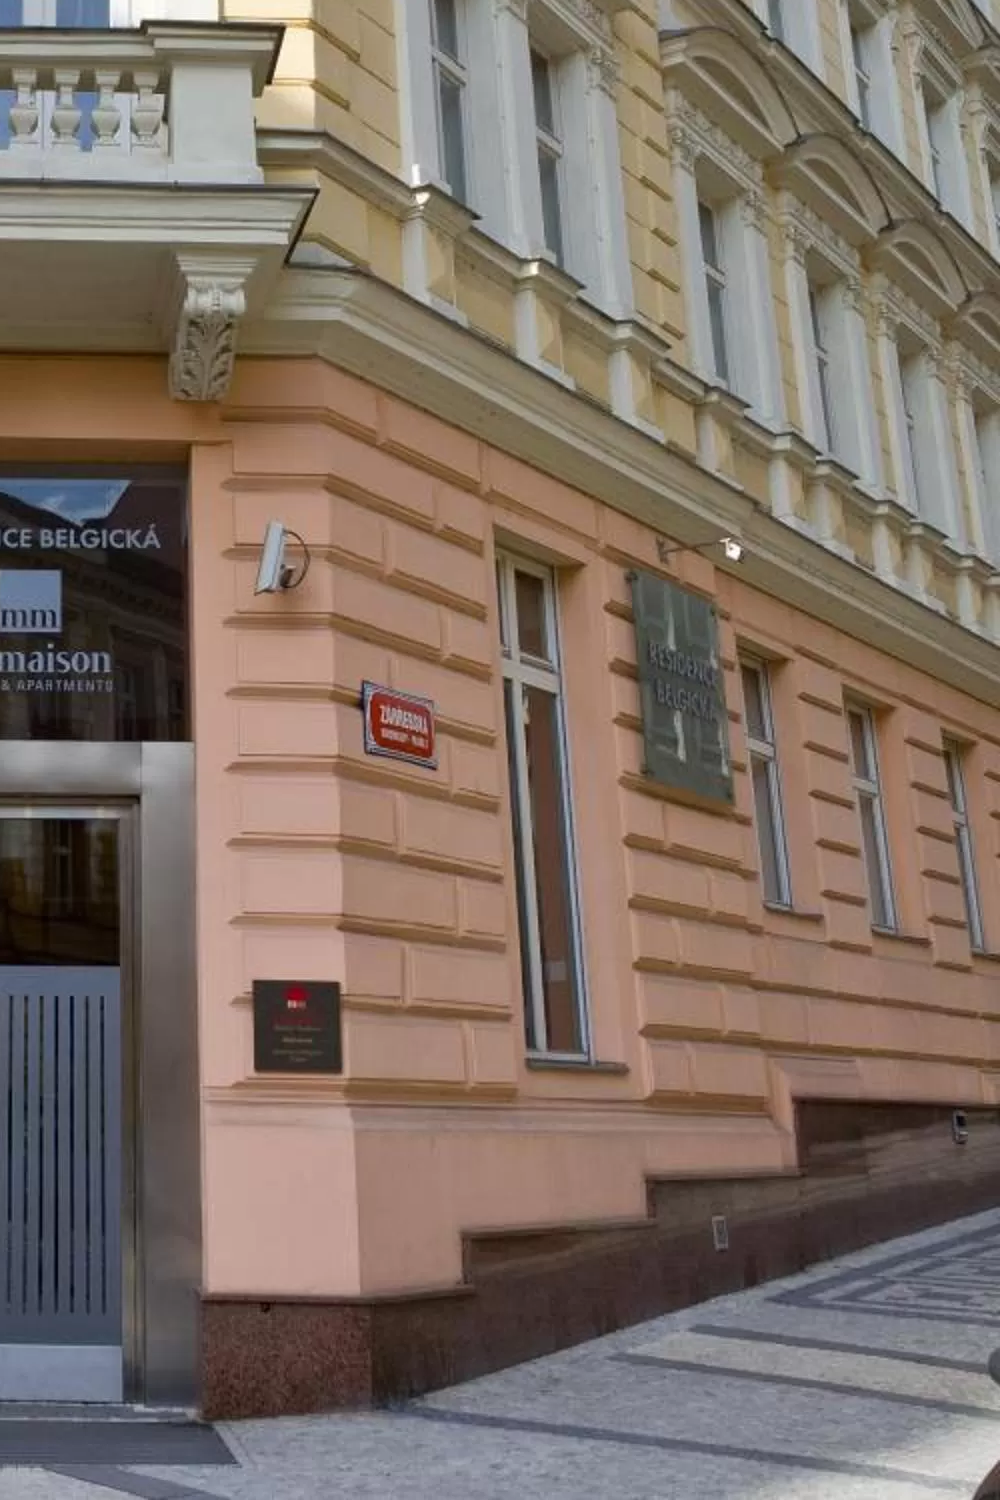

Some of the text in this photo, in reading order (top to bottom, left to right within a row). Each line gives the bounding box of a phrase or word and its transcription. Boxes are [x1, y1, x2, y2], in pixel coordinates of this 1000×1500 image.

[40, 525, 161, 549] BELGICKÁ
[1, 608, 57, 628] mm
[1, 679, 12, 691] &
[16, 679, 113, 692] APARTMENTS
